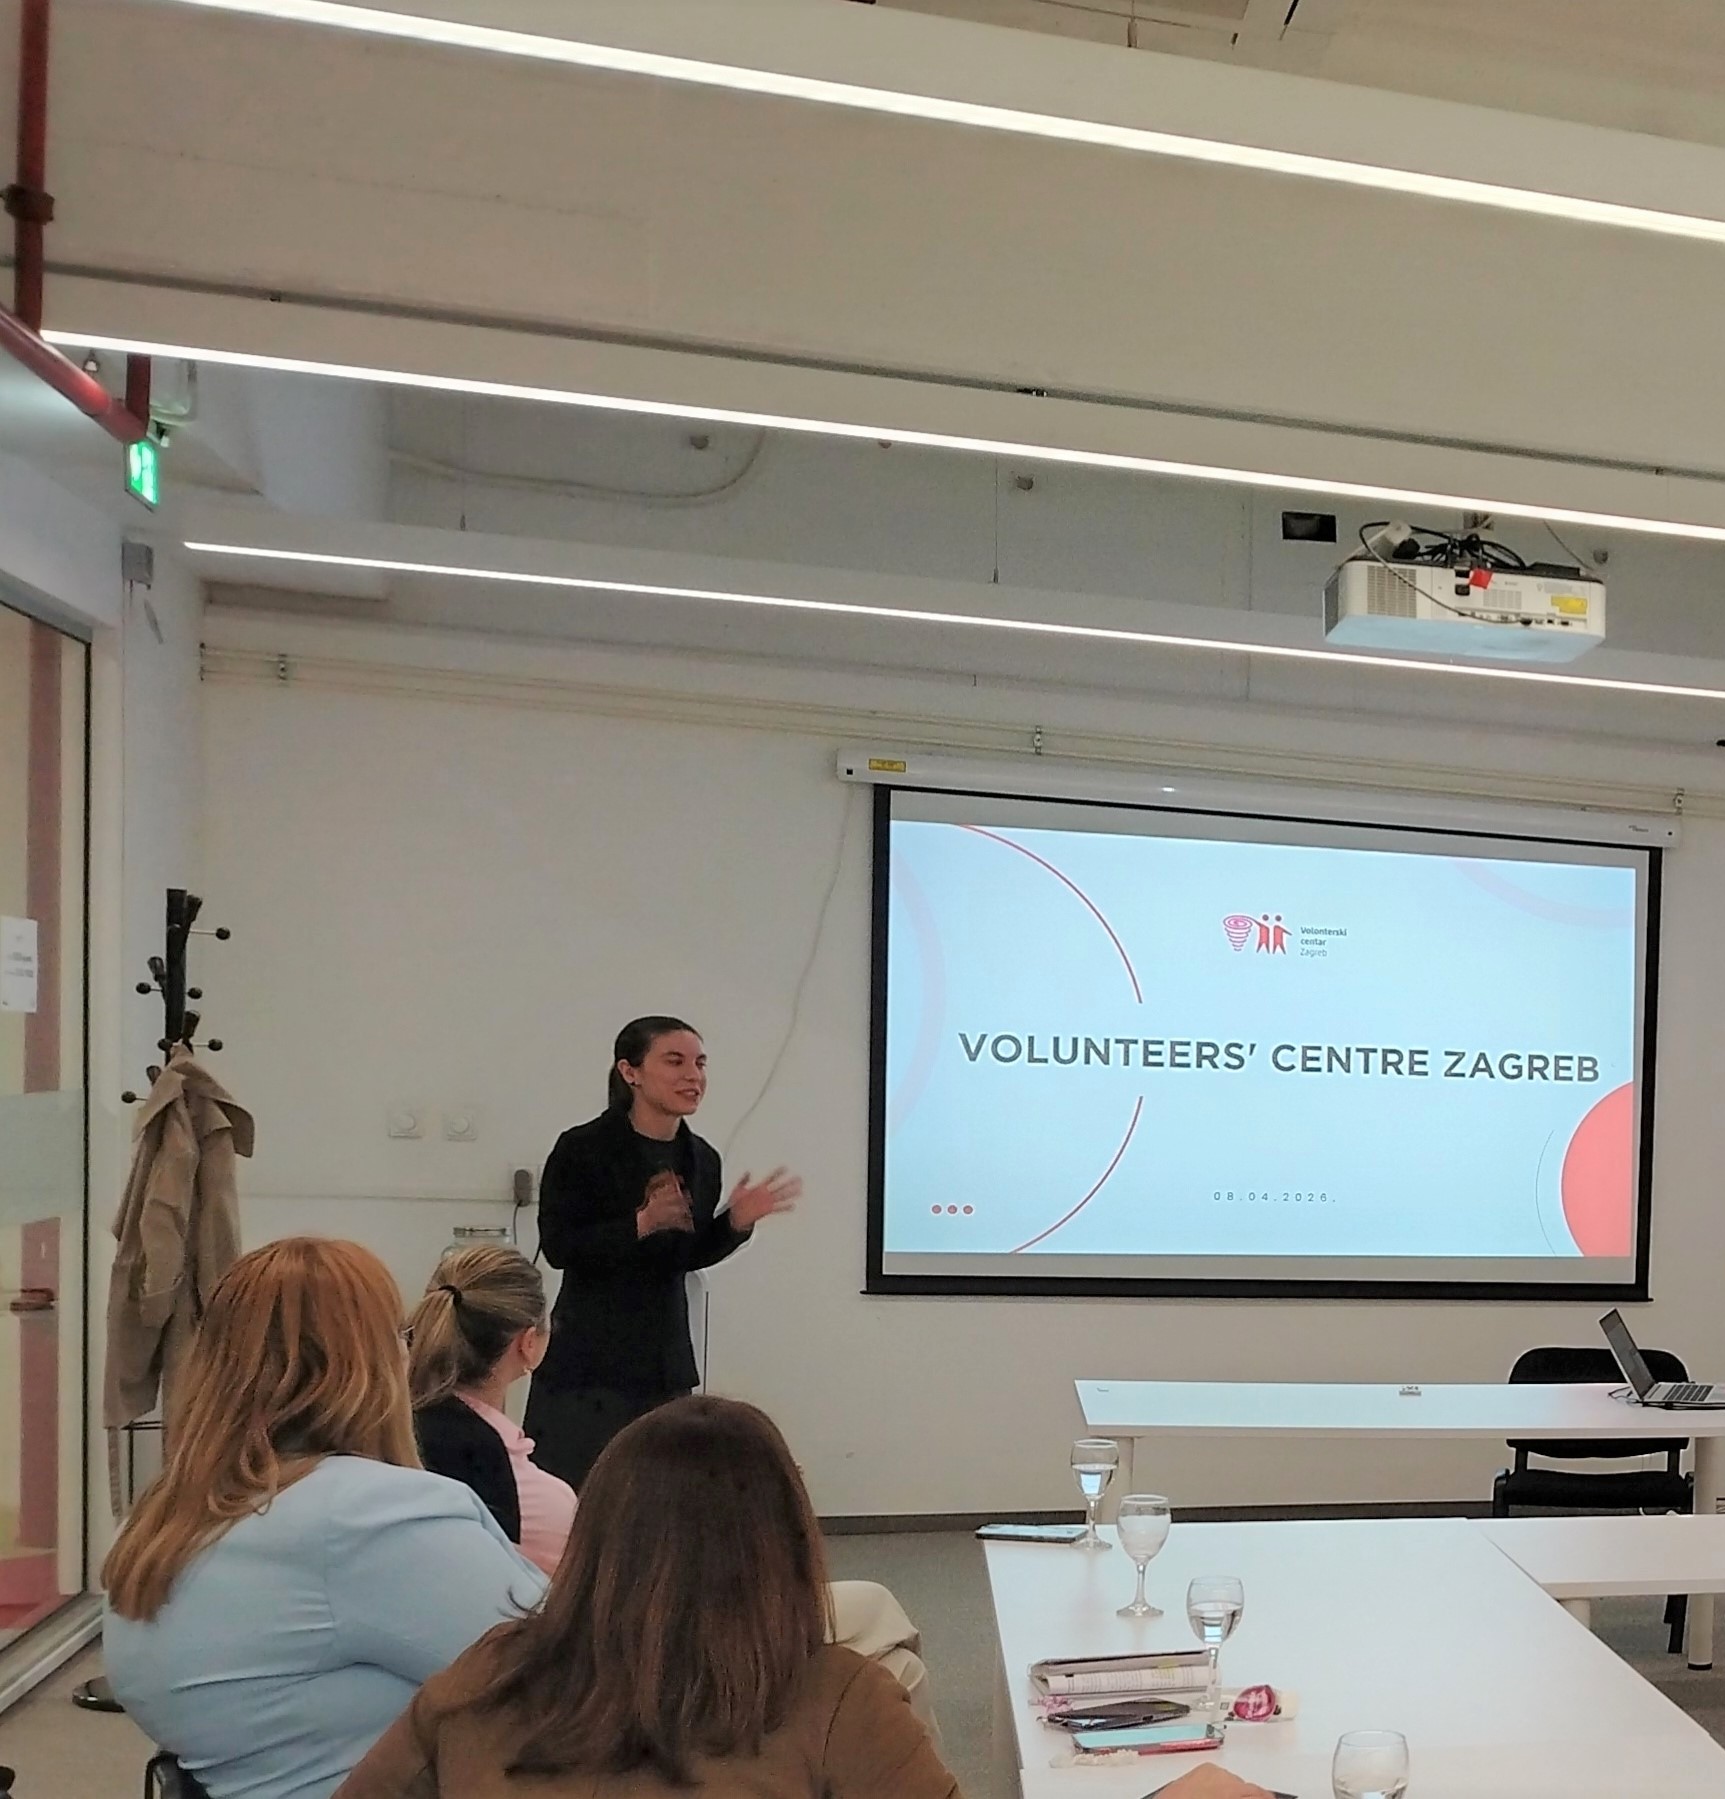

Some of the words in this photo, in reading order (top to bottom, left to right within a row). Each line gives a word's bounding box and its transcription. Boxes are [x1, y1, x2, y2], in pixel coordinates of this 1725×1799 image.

[1300, 926, 1348, 936] Volonterski
[1300, 938, 1327, 946] centar
[1300, 948, 1328, 958] Zagreb
[957, 1032, 1258, 1071] VOLUNTEERS'
[1271, 1044, 1430, 1076] CENTRE
[1443, 1050, 1600, 1083] ZAGREB
